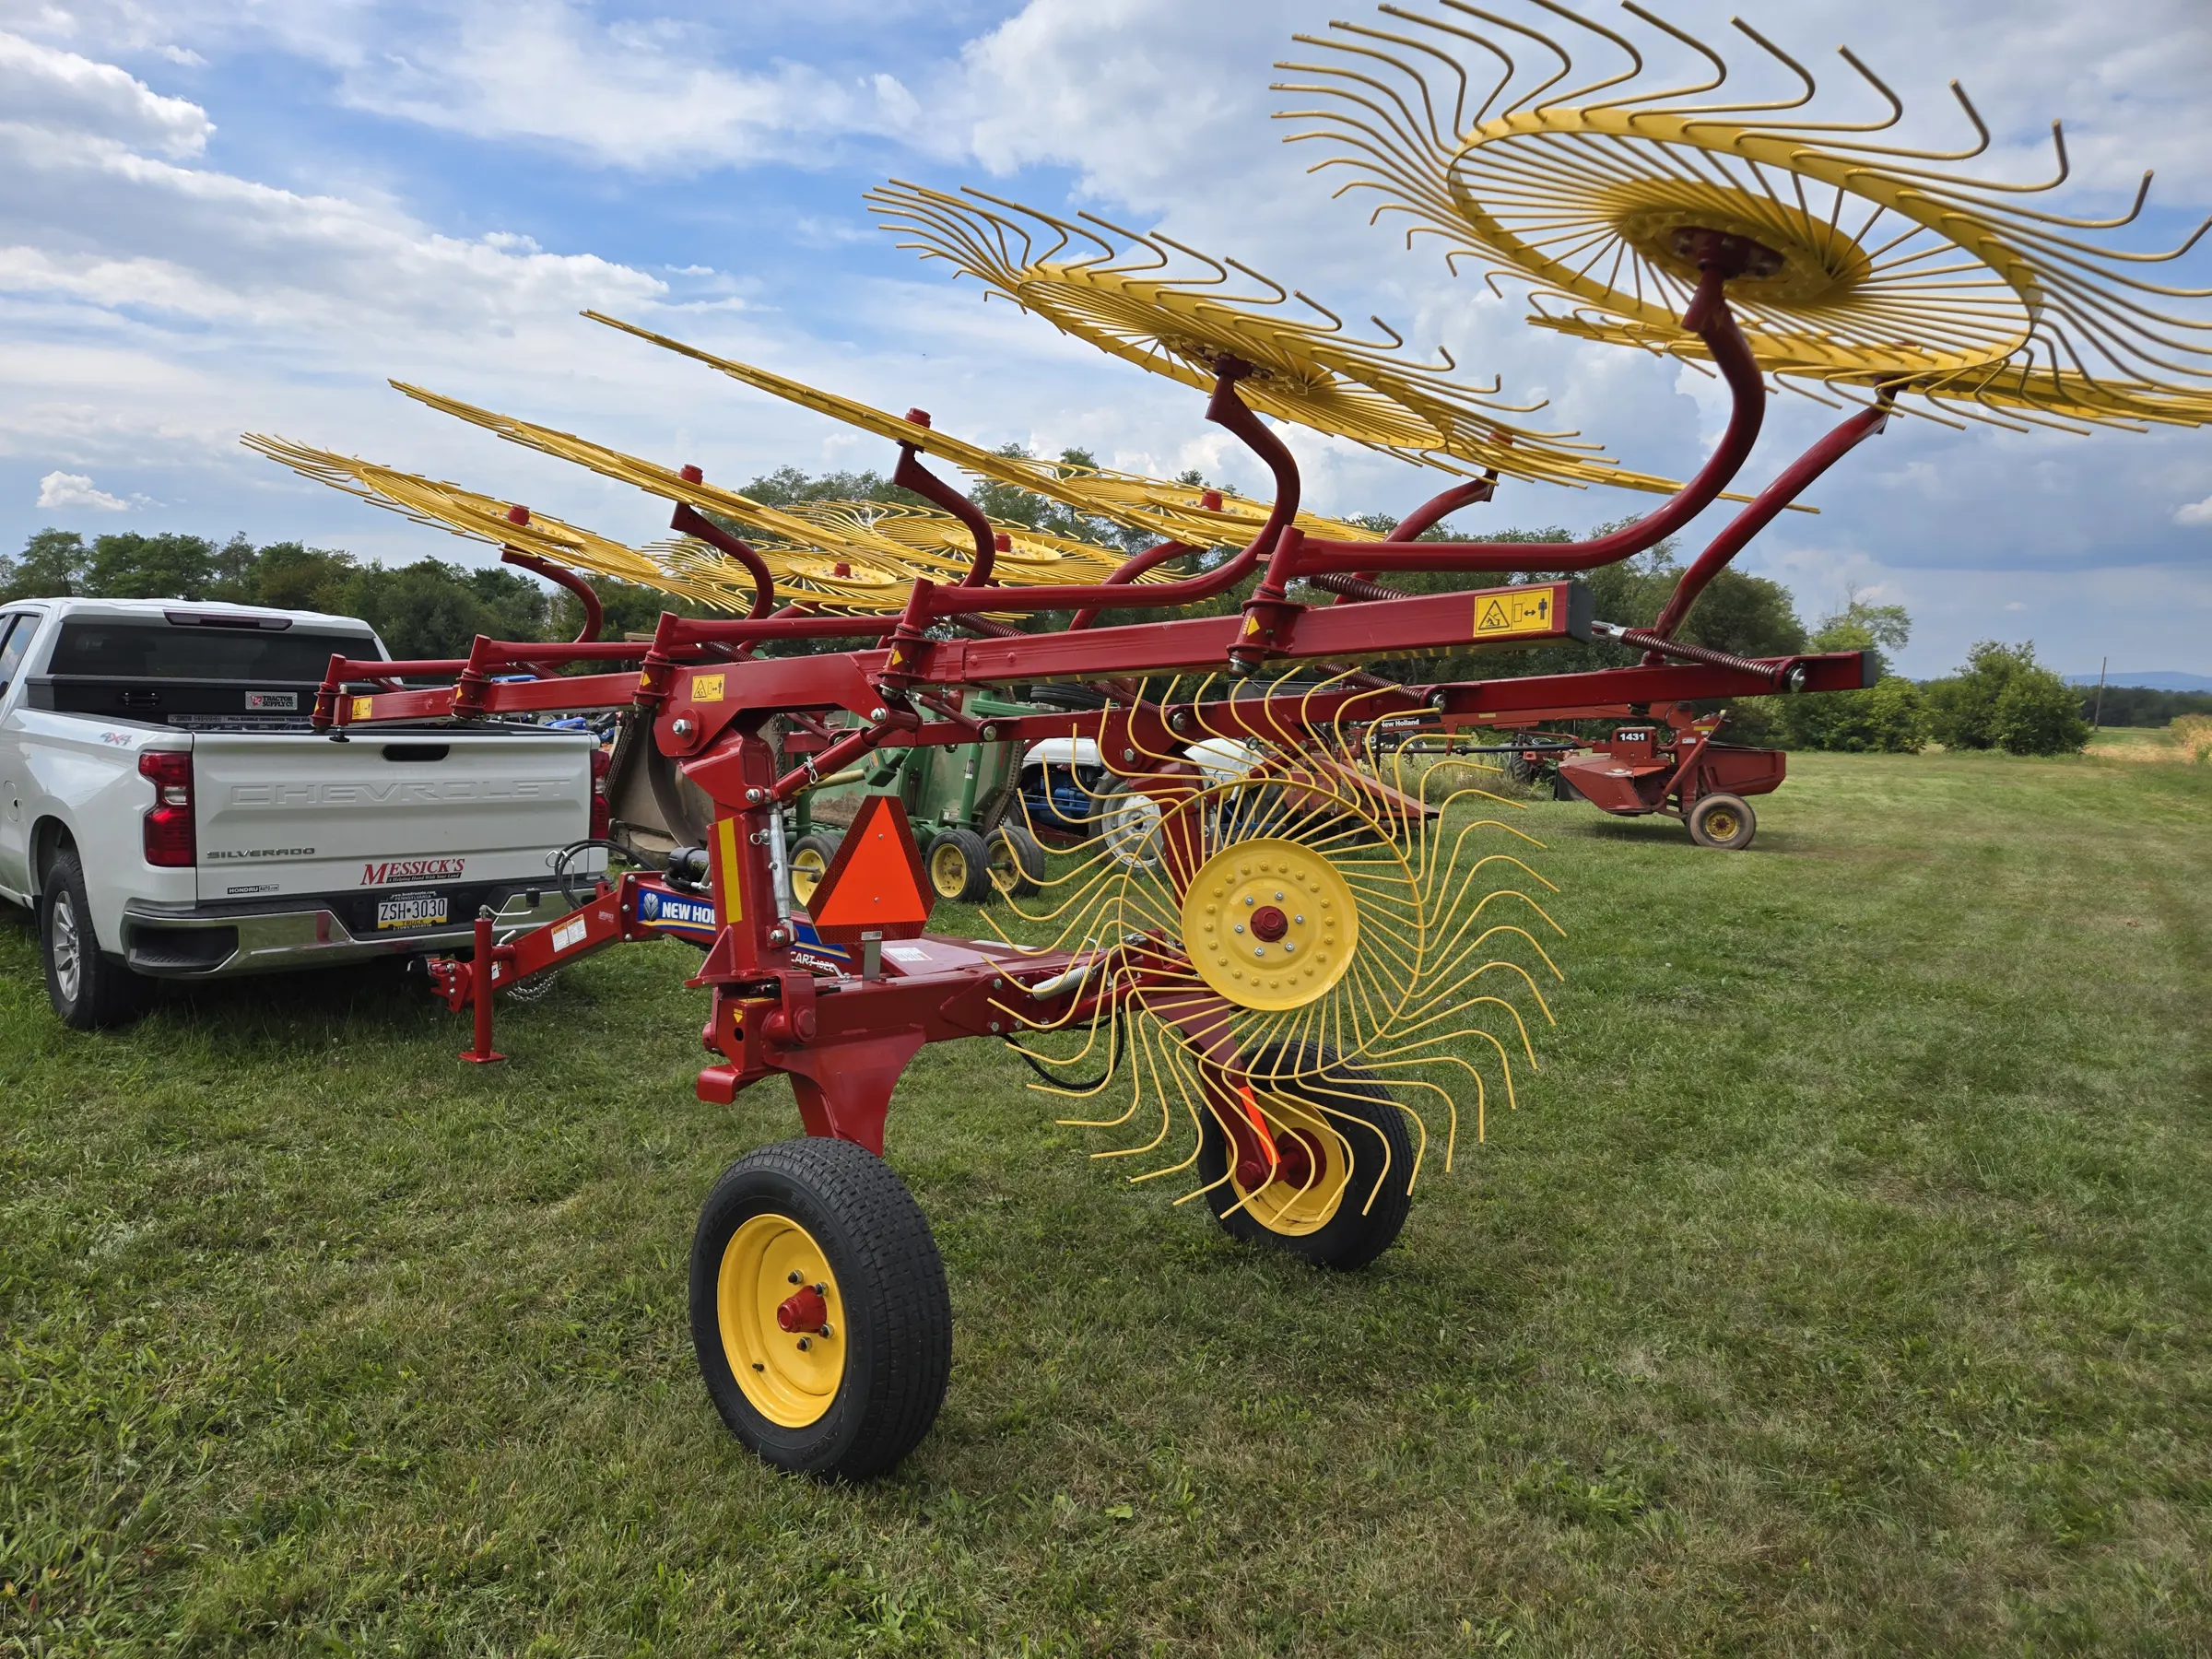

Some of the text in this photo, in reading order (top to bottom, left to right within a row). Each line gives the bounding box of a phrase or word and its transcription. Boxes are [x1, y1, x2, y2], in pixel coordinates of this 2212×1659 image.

[1620, 733, 1645, 741] 1431
[231, 779, 571, 806] CHEVROLET
[206, 847, 315, 859] SILVERADO
[359, 858, 465, 886] MESSICK'S
[229, 886, 258, 894] HONDRU
[662, 902, 690, 920] NEW
